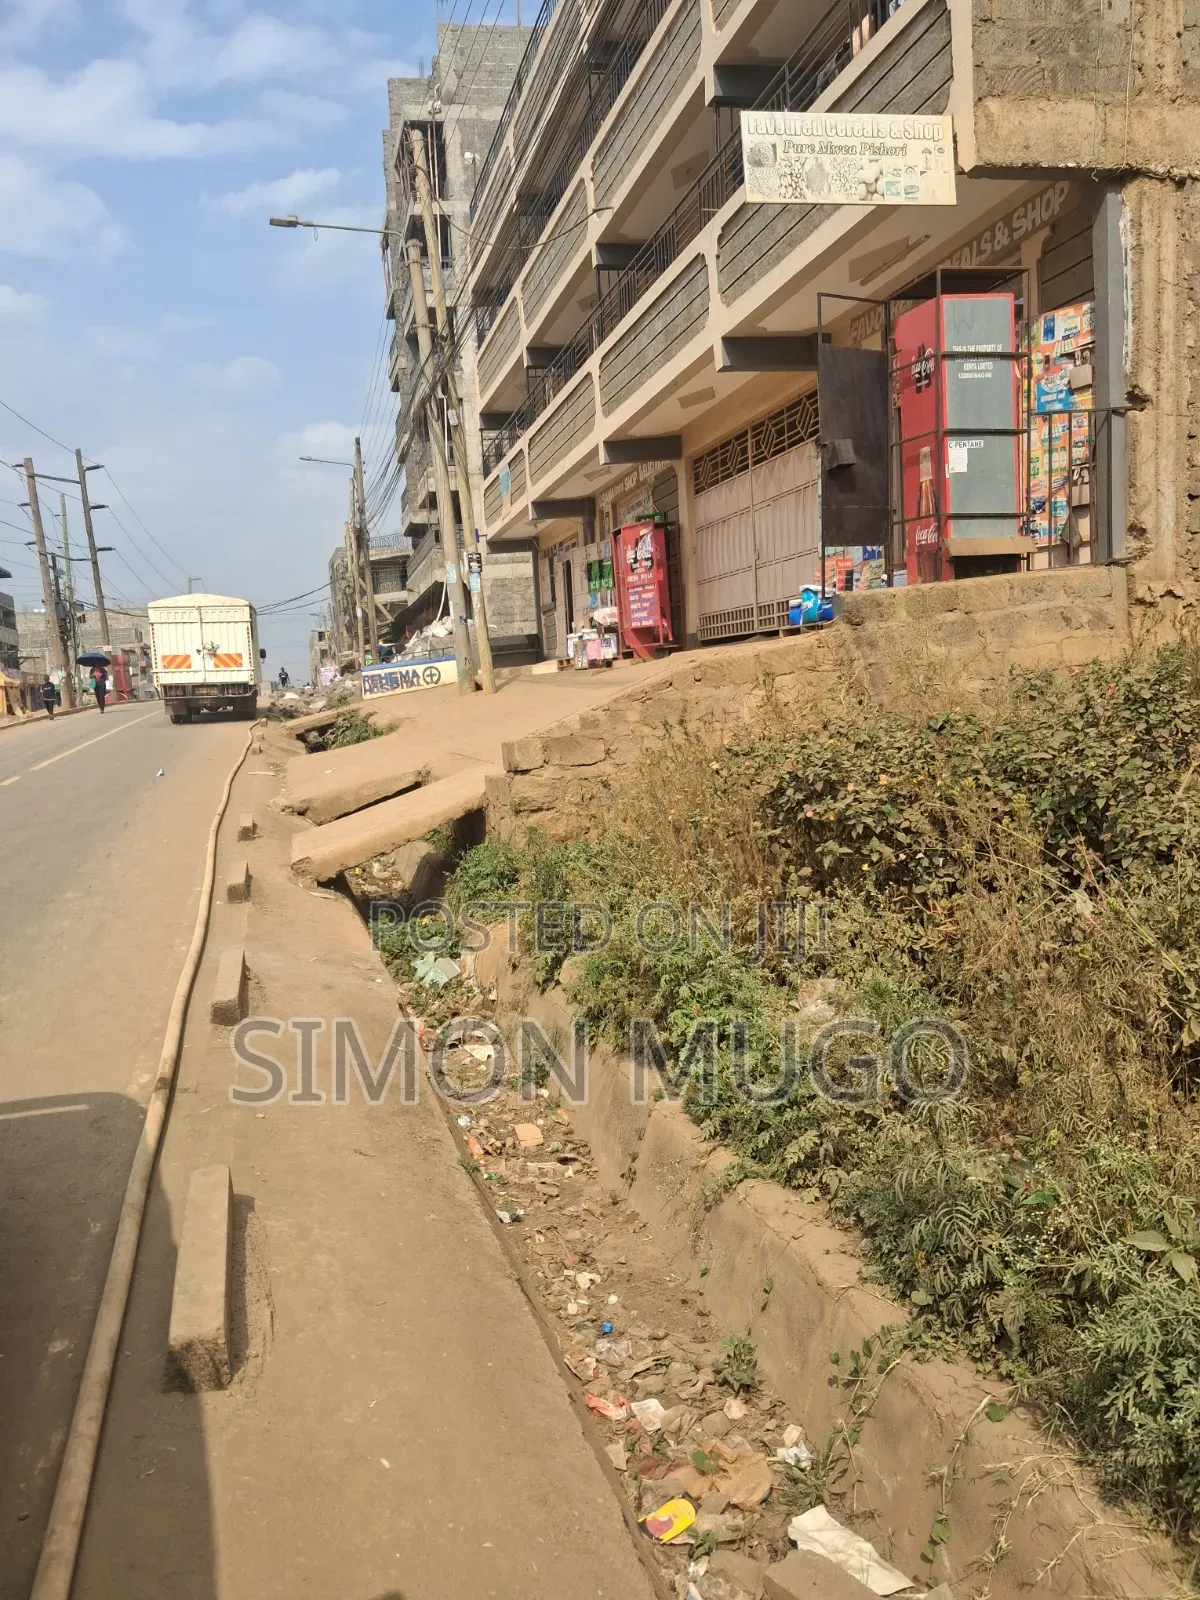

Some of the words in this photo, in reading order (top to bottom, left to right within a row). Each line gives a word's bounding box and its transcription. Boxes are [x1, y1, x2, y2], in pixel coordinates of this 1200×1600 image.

[747, 115, 823, 136] Favoured
[824, 117, 887, 139] Cereals
[889, 122, 902, 139] &
[903, 119, 944, 142] Shop
[783, 139, 816, 154] Pure
[817, 140, 857, 155] Mwea
[859, 142, 908, 156] Pishori
[993, 221, 1010, 251] &
[1012, 181, 1069, 240] SHOP
